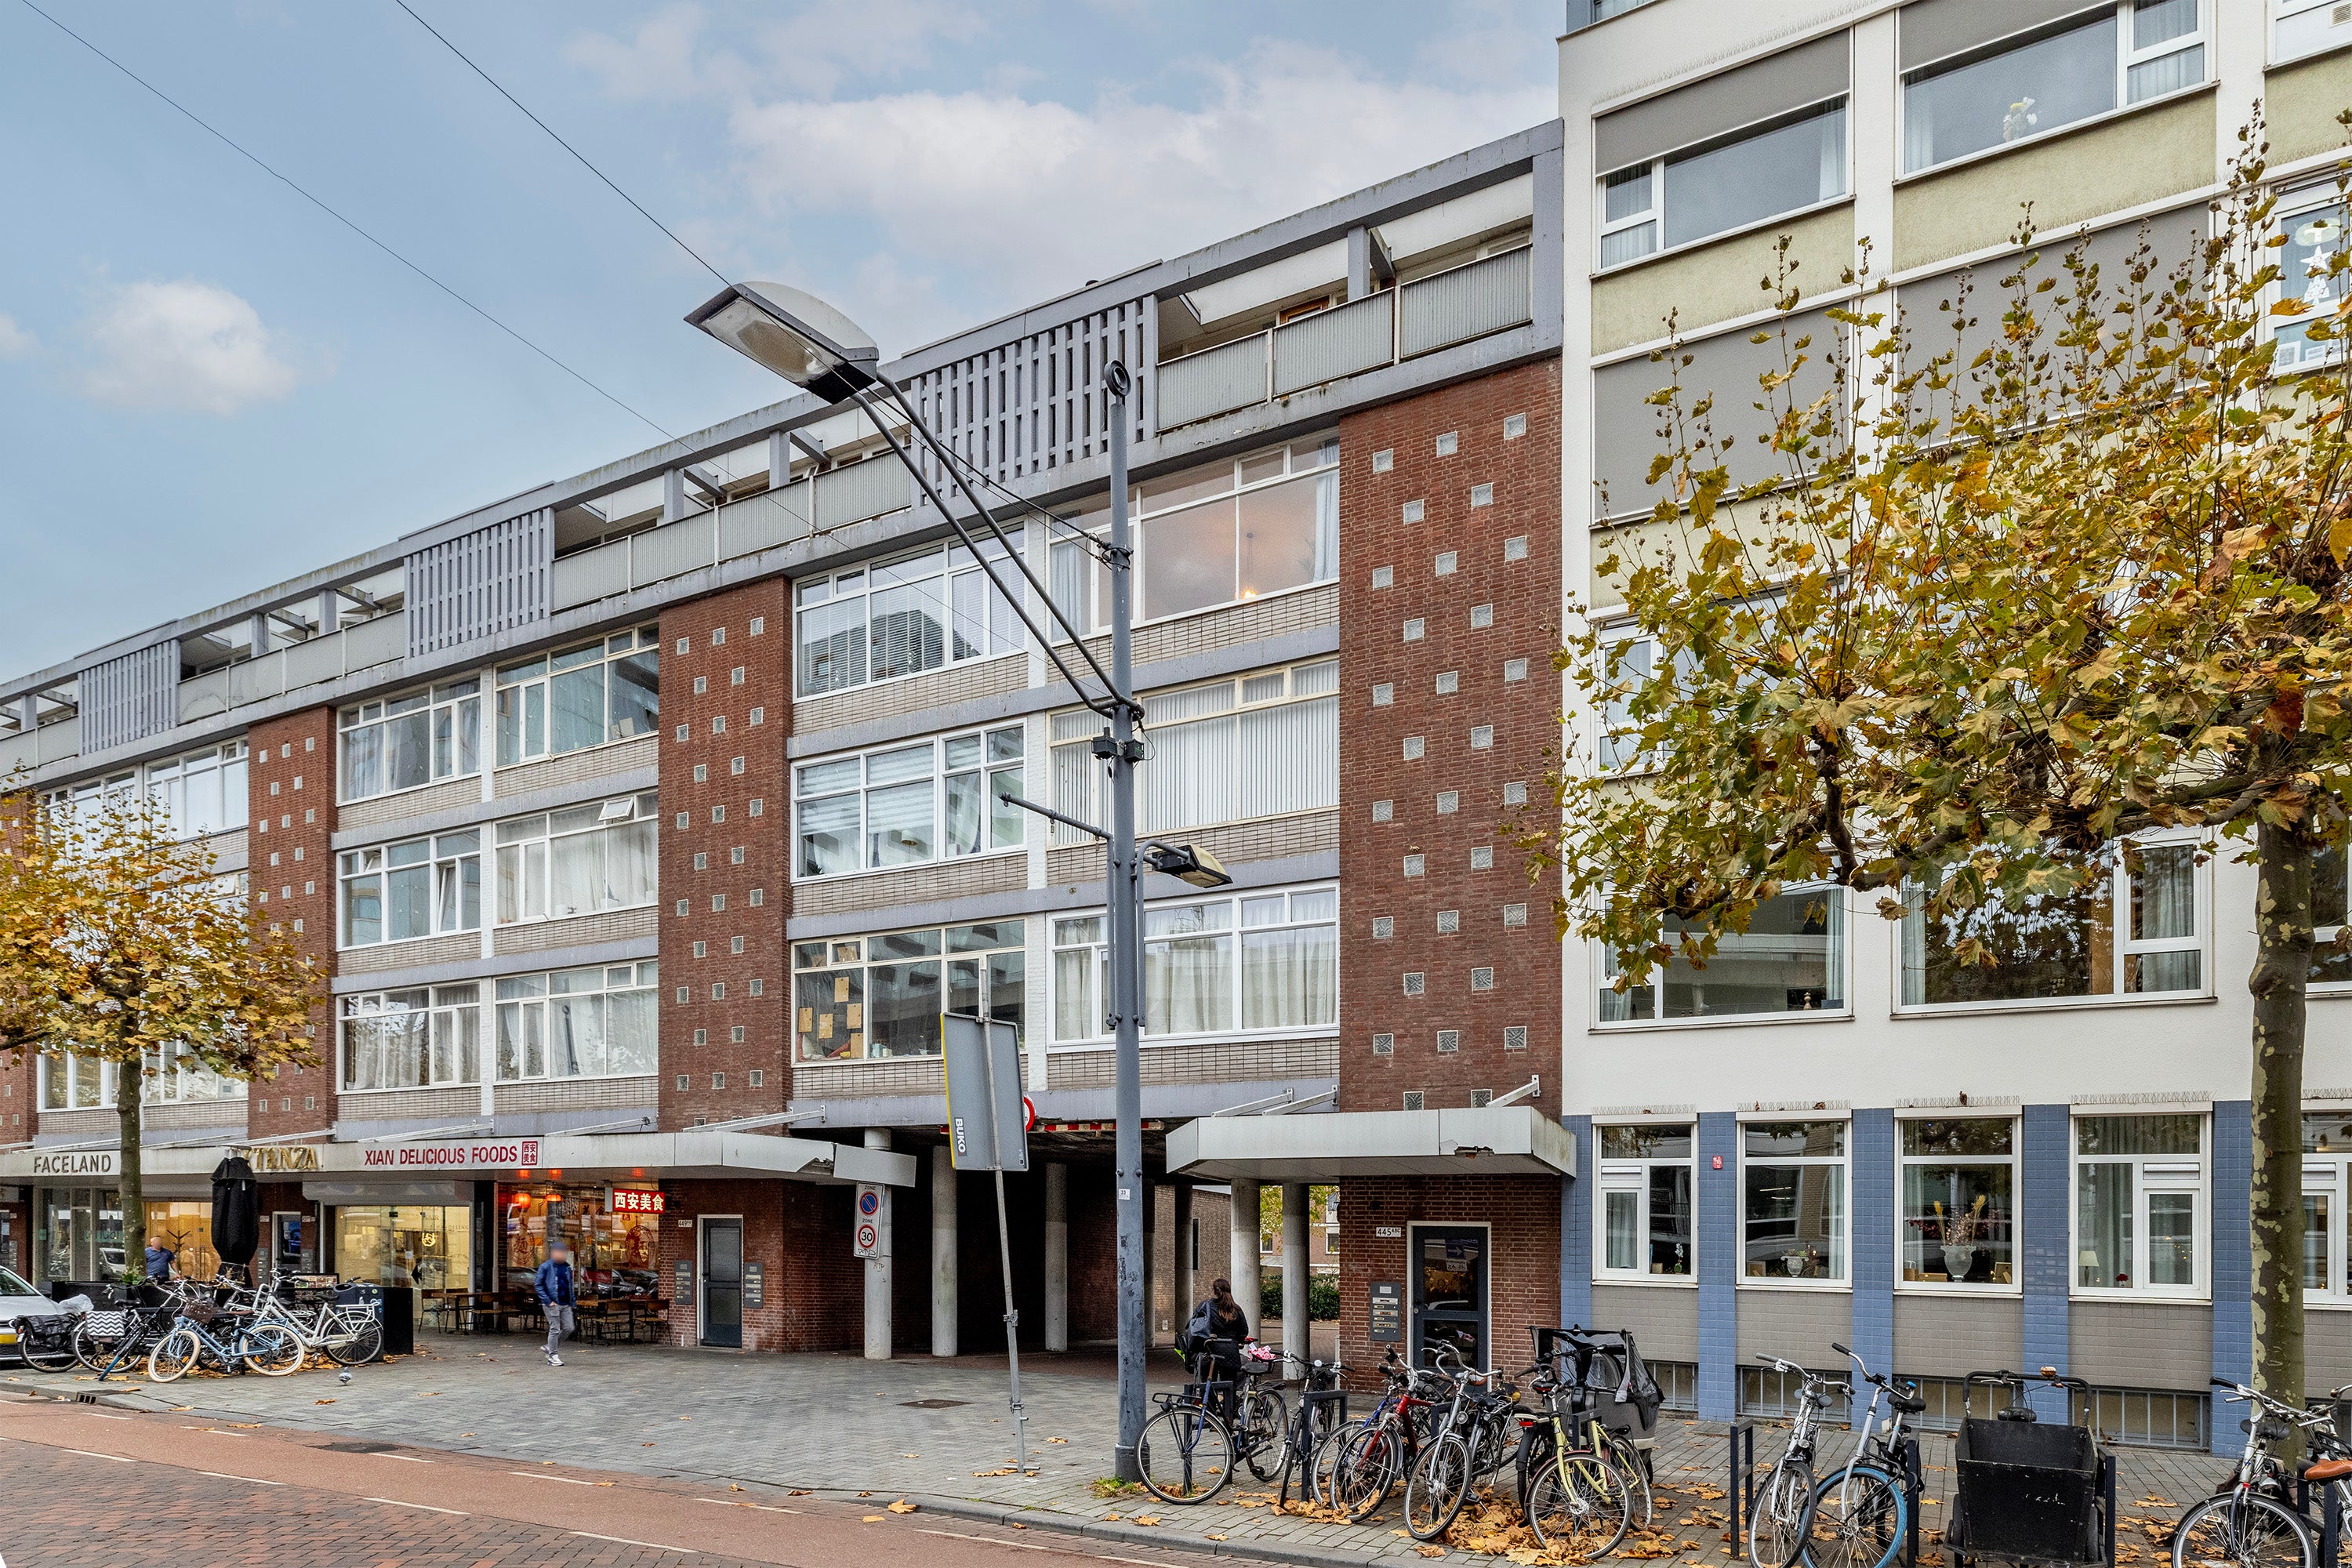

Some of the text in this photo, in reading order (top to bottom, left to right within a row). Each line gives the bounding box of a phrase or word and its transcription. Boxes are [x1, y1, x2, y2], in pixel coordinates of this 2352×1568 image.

[955, 1118, 966, 1153] BUKO
[34, 1155, 111, 1173] FACELAND
[365, 1145, 517, 1165] XIAN DELICIOUS FOODS
[614, 1192, 664, 1211] 西安美食
[861, 1232, 873, 1242] 30
